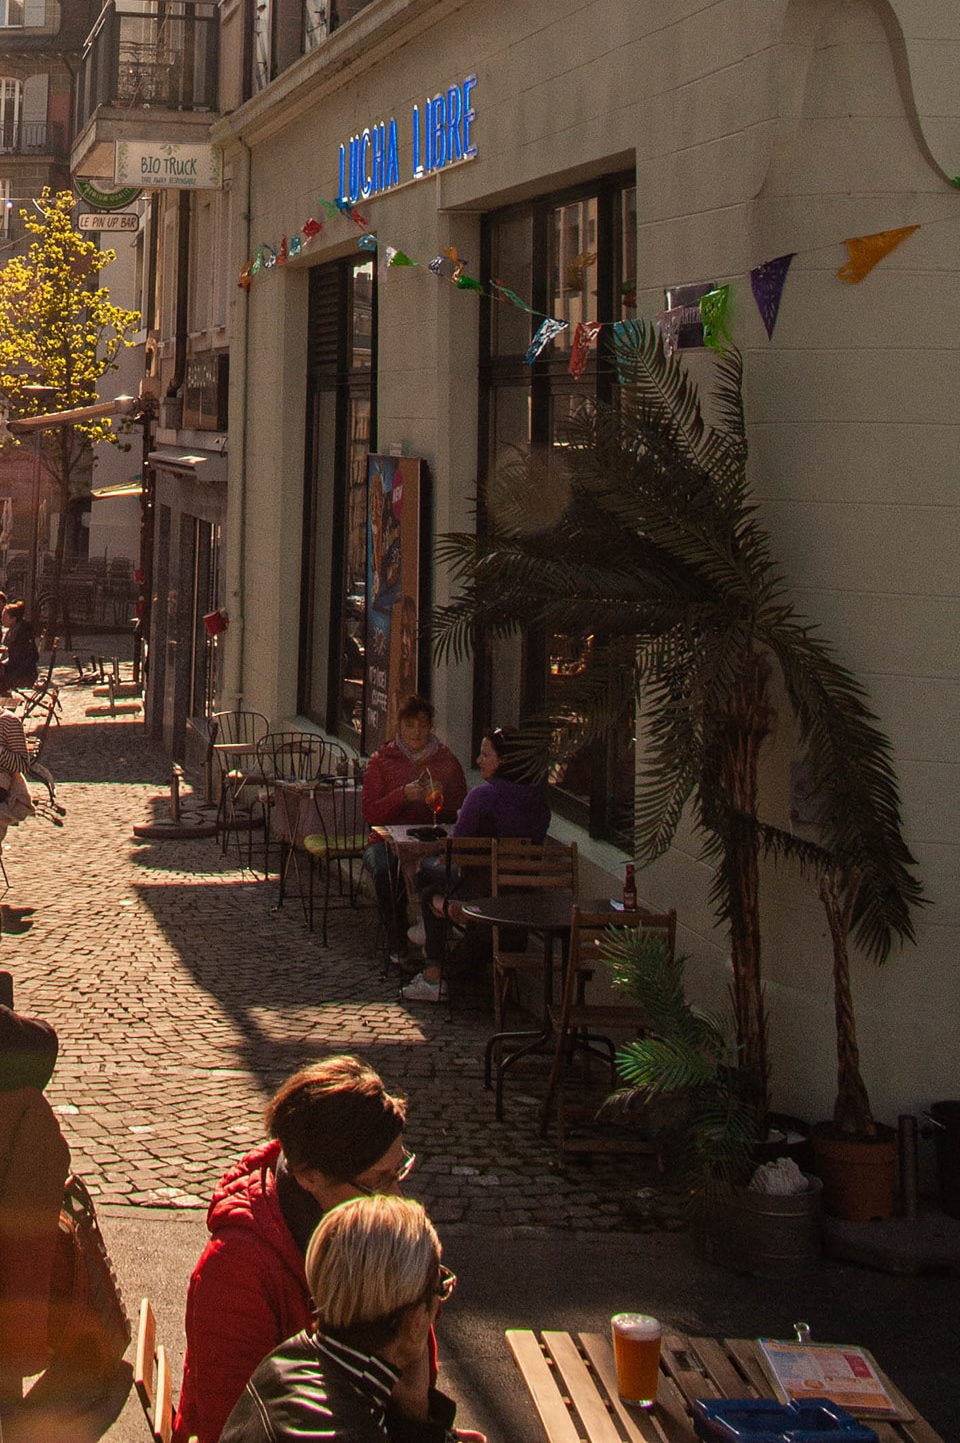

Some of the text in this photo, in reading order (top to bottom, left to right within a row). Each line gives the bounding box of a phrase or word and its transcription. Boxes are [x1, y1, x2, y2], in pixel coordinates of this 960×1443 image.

[339, 73, 478, 204] LUCHA LIBRE
[141, 156, 197, 175] BIO TRUCK
[80, 216, 137, 228] LE PIN UP BAR
